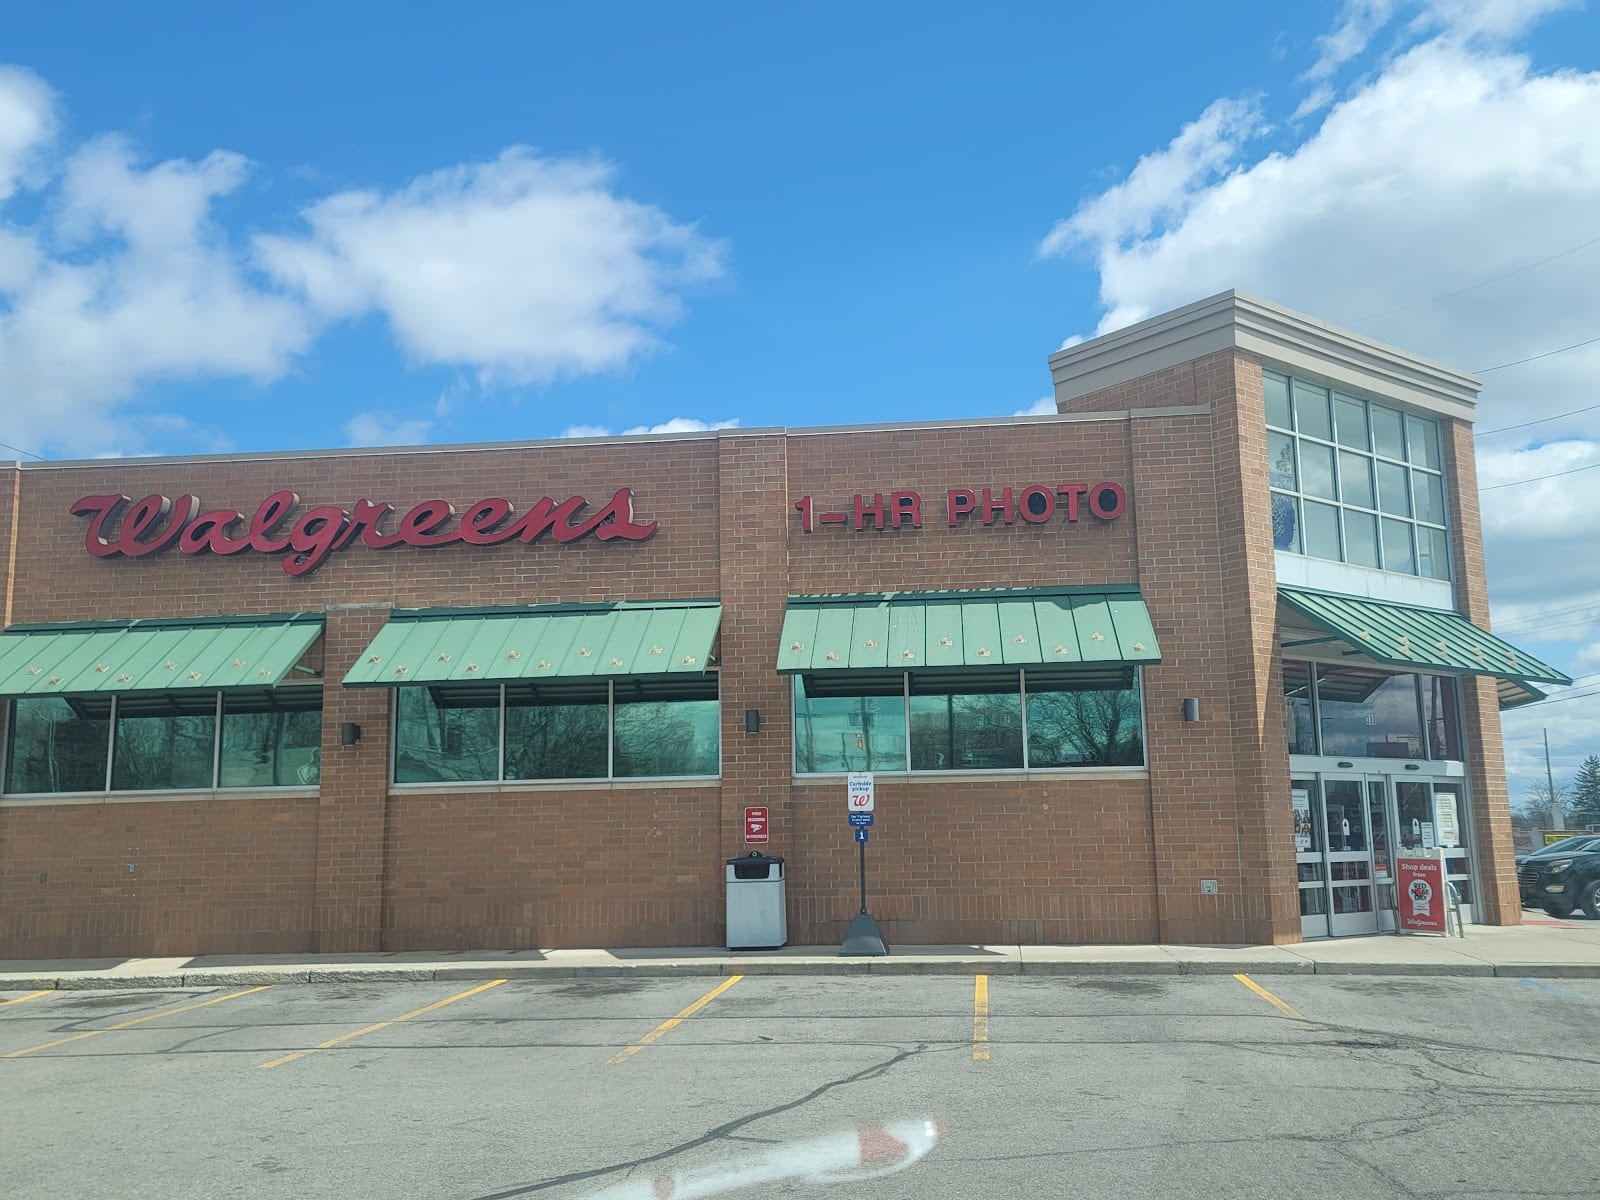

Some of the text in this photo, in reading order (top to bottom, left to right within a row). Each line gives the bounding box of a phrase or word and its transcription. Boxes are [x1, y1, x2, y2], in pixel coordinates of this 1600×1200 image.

[795, 481, 1126, 533] 1-HR PHOTO
[69, 488, 660, 576] Walgreens
[859, 830, 865, 840] 1
[1401, 863, 1438, 871] Shop deals
